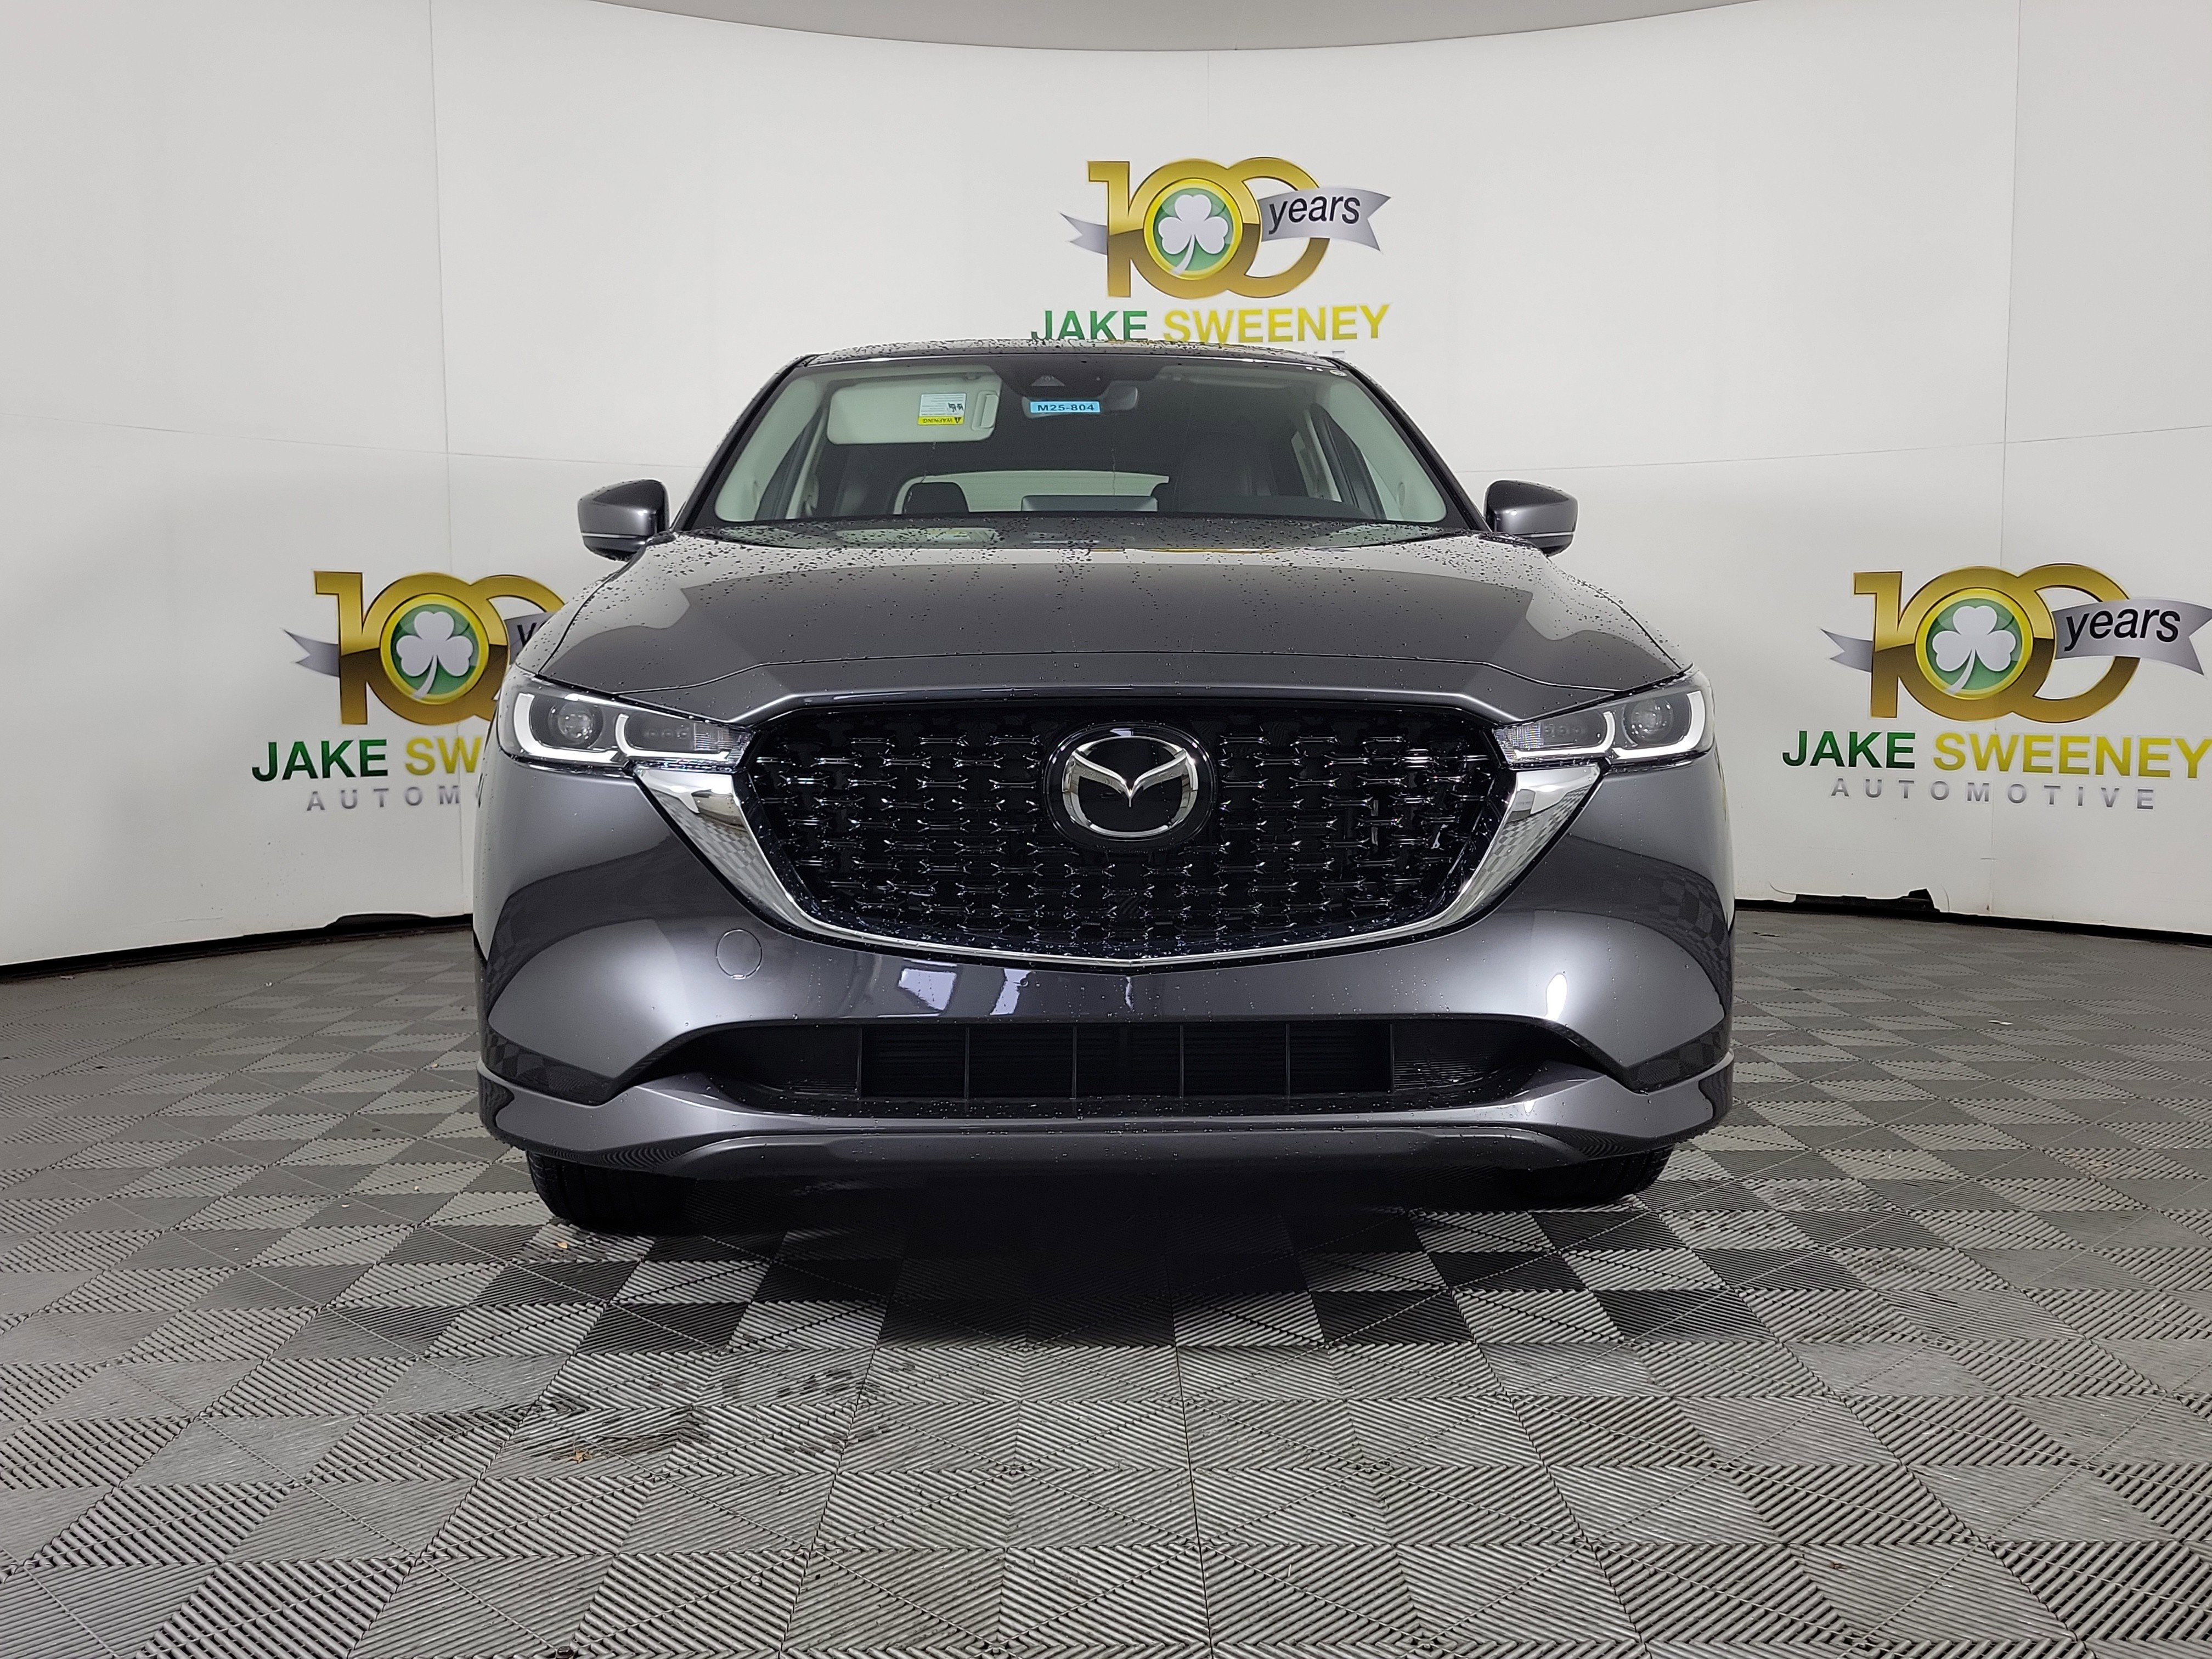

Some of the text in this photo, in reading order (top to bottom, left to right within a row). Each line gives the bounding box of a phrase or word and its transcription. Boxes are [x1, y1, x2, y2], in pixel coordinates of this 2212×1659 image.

[1087, 156, 1362, 300] 100 years
[1031, 304, 1390, 343] JAKE SWEENEY
[1853, 563, 2181, 723] 100 years
[252, 738, 388, 781] JAKE
[1782, 731, 2212, 778] JAKE SWEENEY
[307, 786, 478, 811] AUTOM
[1831, 778, 2154, 810] AUTOMOTIVE
